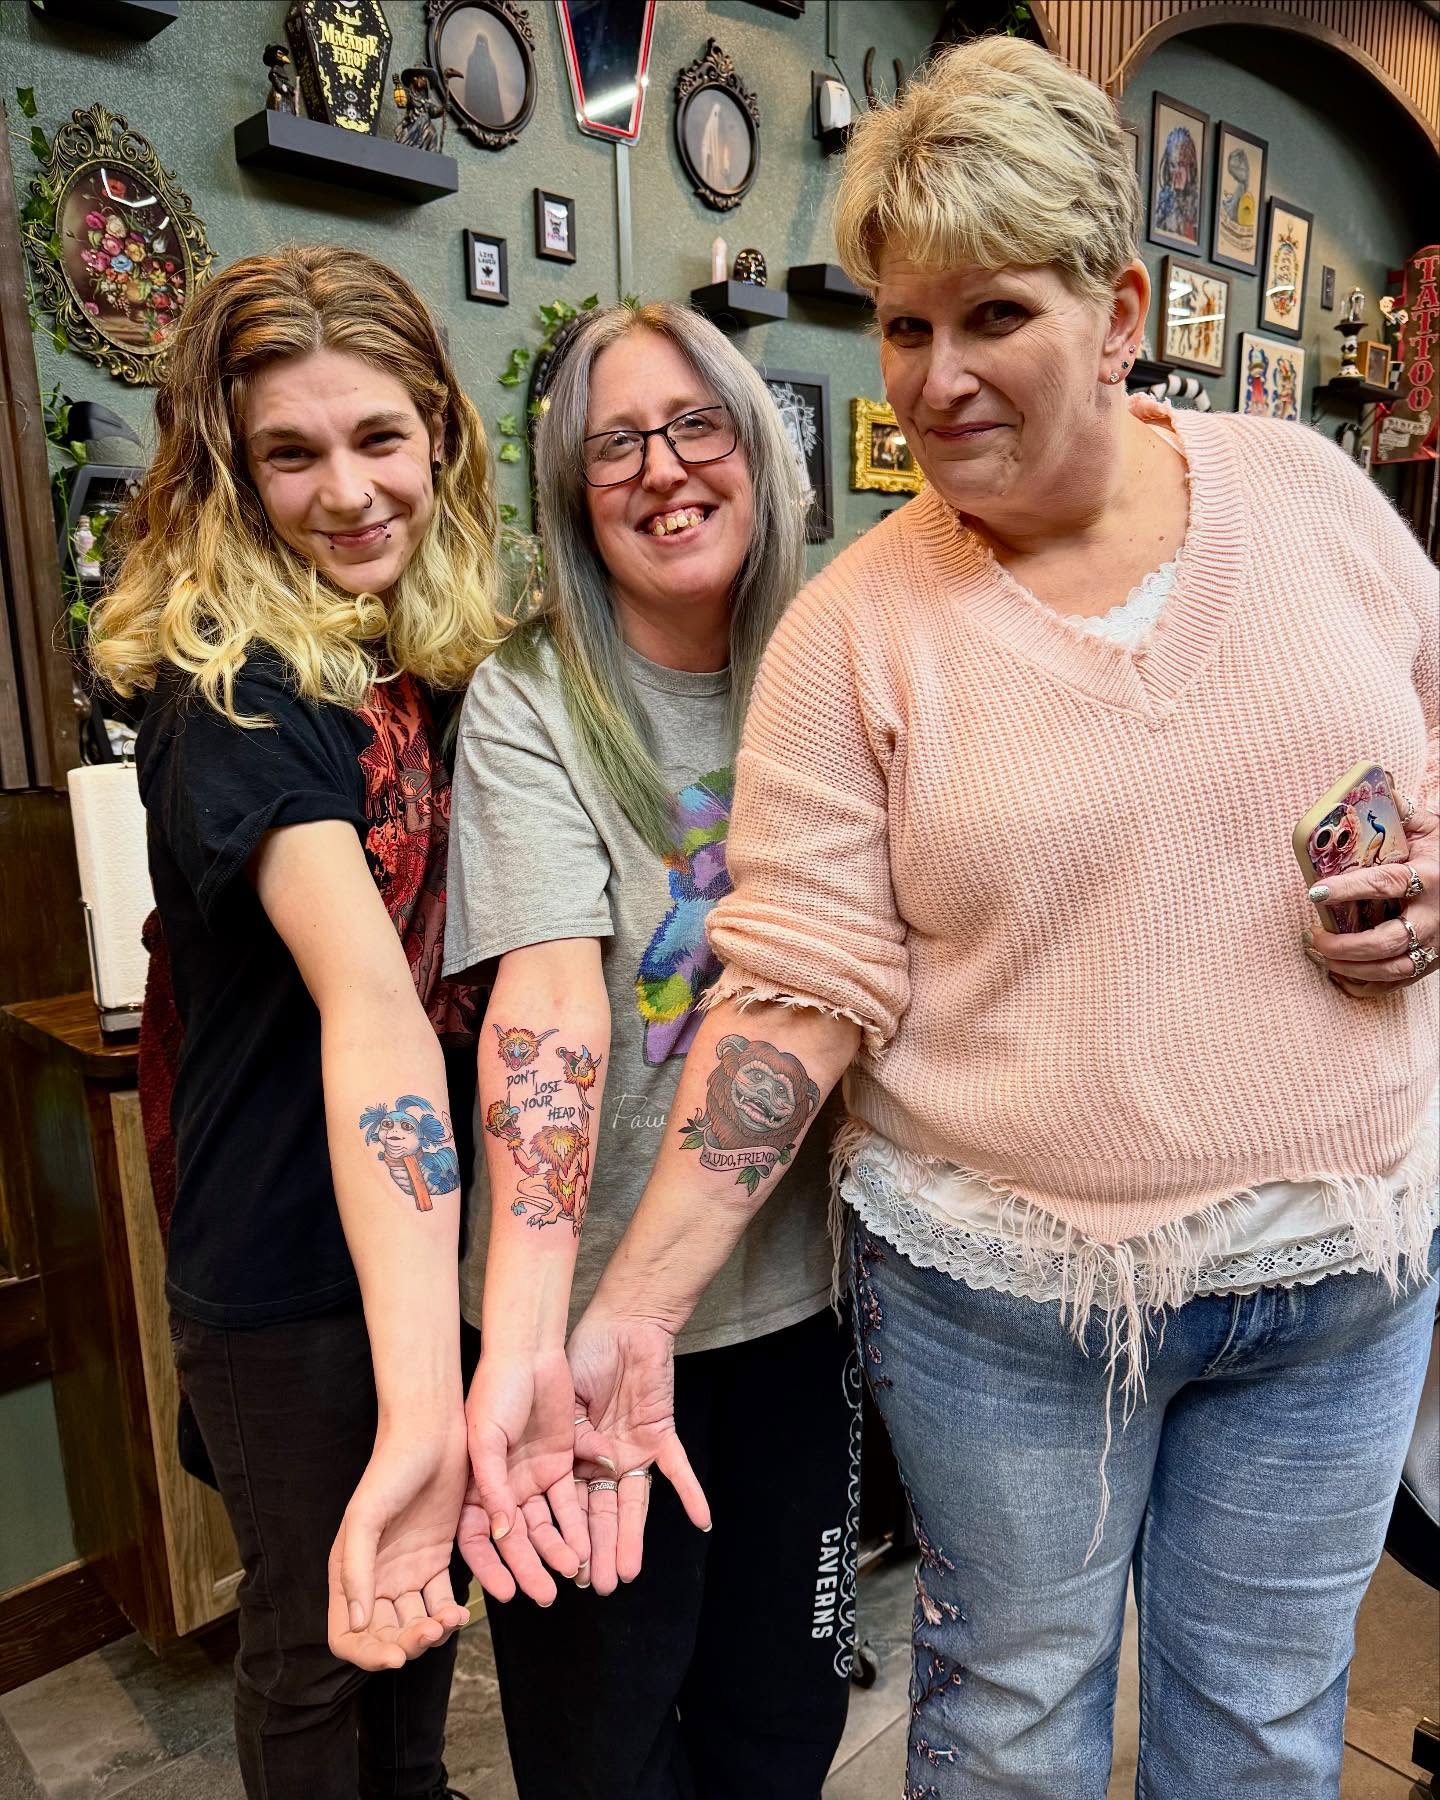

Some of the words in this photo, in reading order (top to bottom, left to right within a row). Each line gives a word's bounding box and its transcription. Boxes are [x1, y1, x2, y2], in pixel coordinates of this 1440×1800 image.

[331, 45, 367, 70] TAROT
[1407, 255, 1440, 412] TATTOO
[506, 1069, 538, 1089] DON'T
[534, 1080, 562, 1096] LOSE
[521, 1095, 553, 1112] YOUR
[547, 1106, 576, 1121] HEAD
[811, 1526, 842, 1639] CAVERNS
